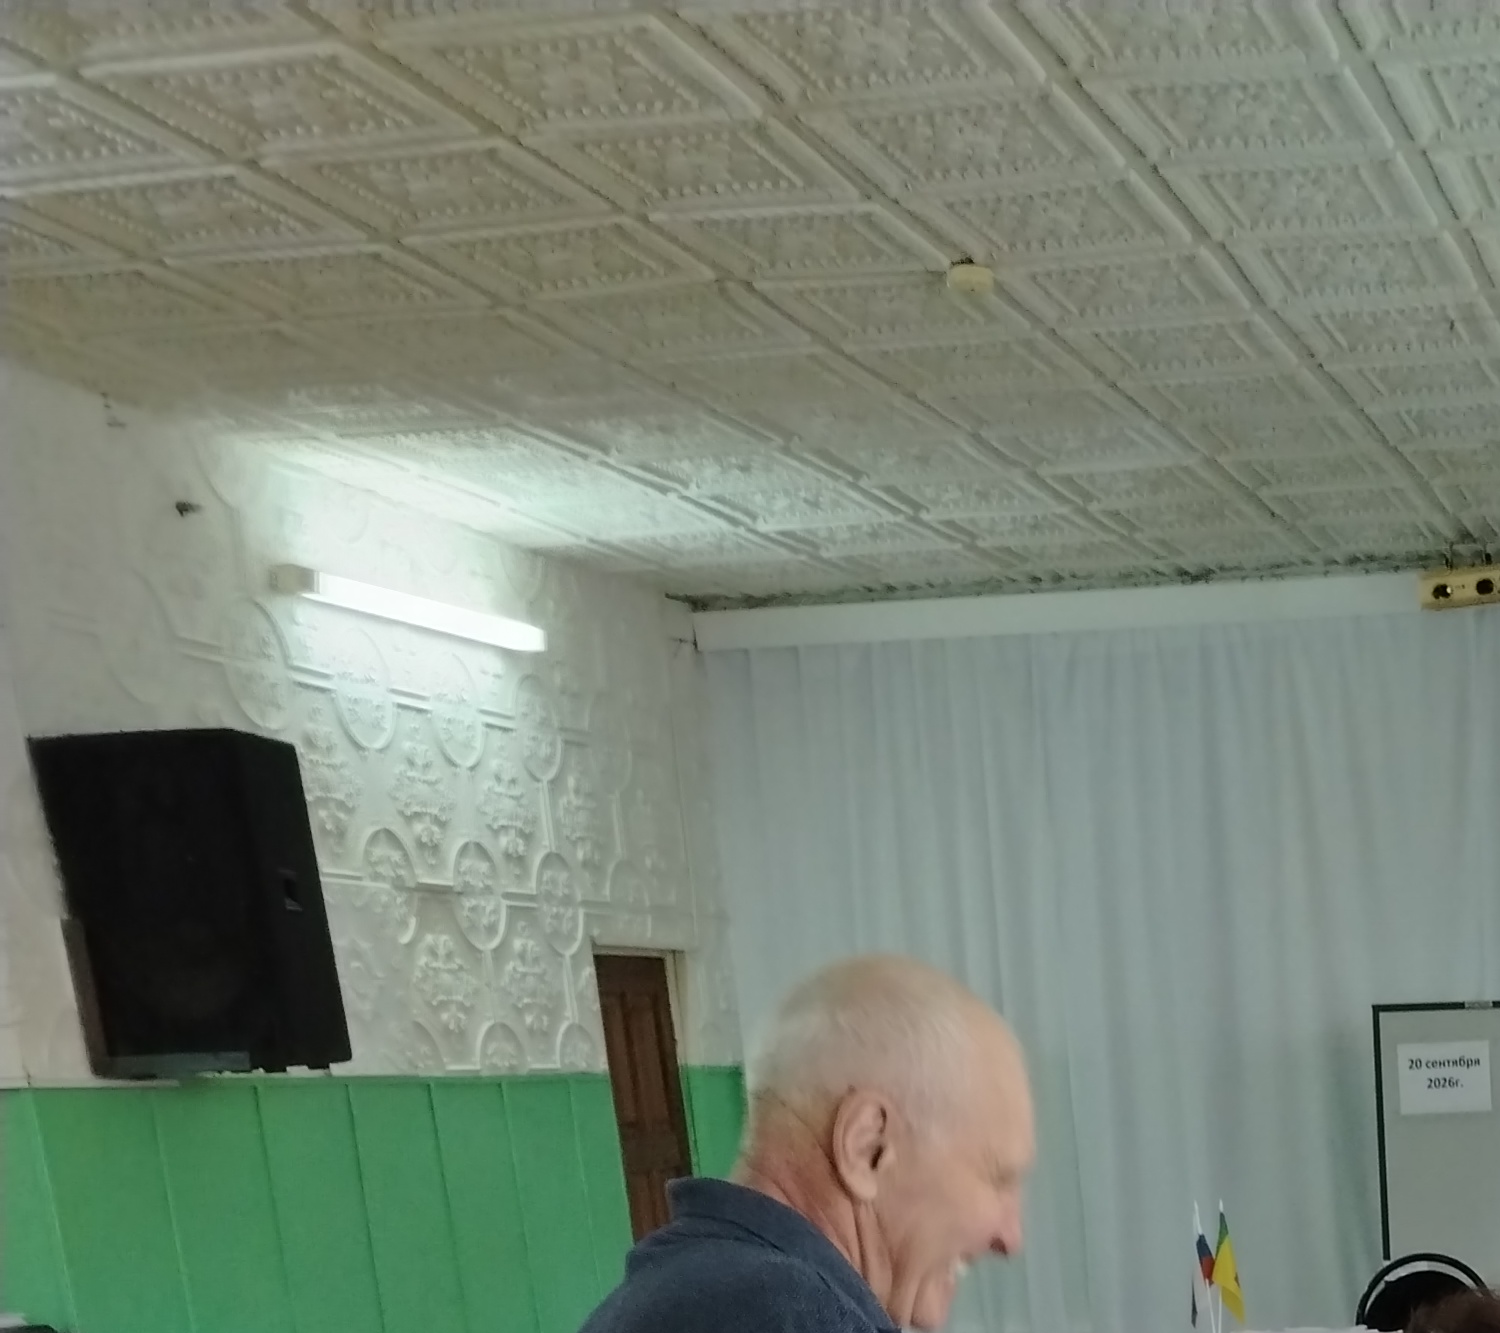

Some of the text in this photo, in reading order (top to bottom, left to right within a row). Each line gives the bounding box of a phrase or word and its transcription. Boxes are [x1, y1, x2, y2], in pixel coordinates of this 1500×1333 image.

[1408, 1055, 1481, 1070] 20 сентября
[1427, 1077, 1464, 1089] 2026г.
